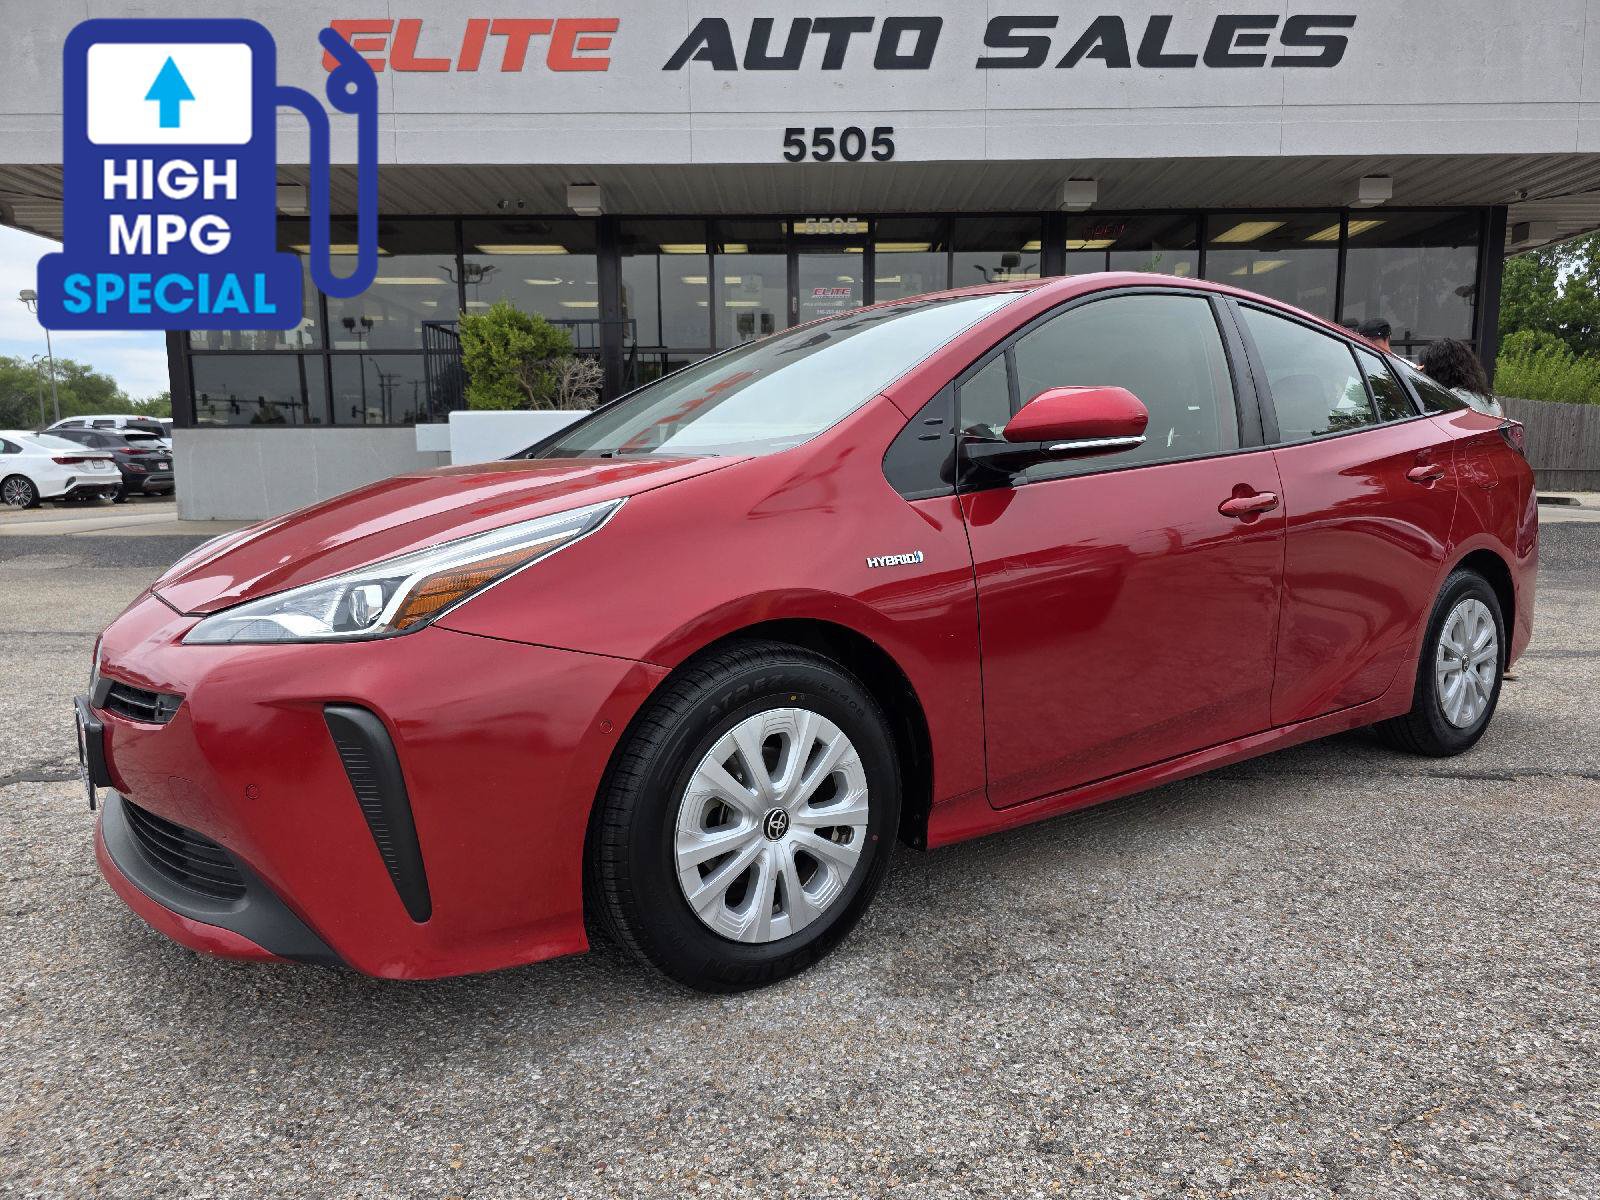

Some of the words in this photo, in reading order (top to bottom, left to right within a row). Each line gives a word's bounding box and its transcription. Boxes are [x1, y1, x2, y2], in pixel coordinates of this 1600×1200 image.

[322, 18, 619, 72] ELITE
[662, 16, 943, 71] AUTO
[976, 14, 1356, 69] SALES
[783, 126, 896, 162] 5505
[805, 217, 858, 235] 5505
[812, 287, 852, 296] ELITE
[866, 552, 916, 568] HYBRID
